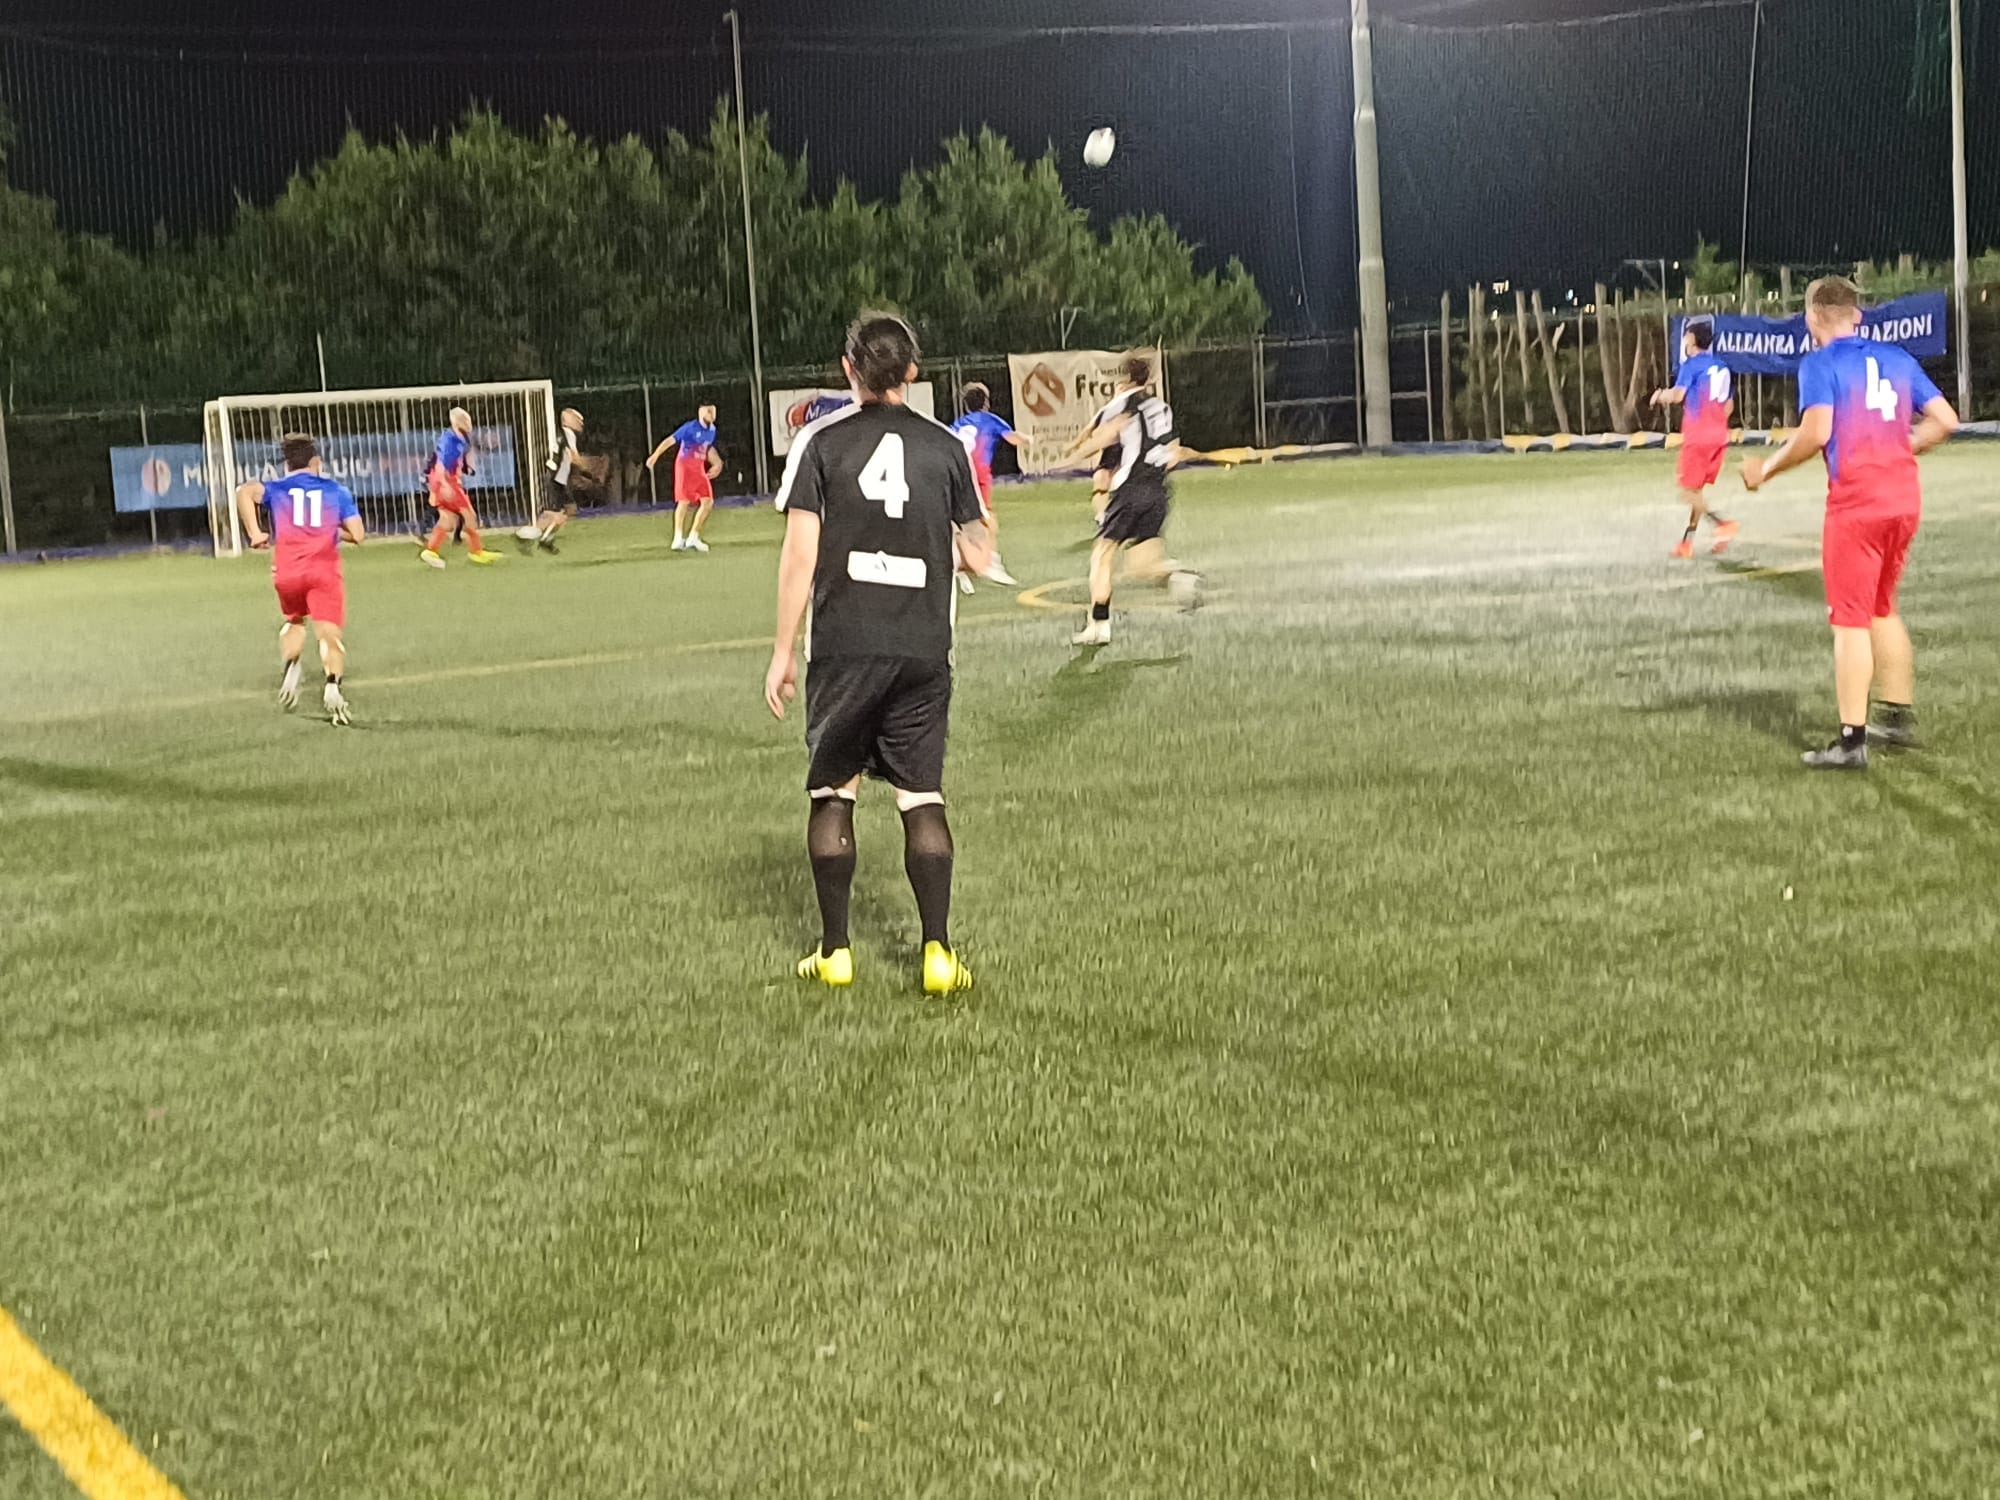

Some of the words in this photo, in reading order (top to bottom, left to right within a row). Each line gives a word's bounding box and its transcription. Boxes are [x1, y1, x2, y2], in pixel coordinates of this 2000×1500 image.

[1717, 331, 1795, 354] ALLEANZA
[1707, 365, 1731, 403] 10
[1864, 357, 1898, 422] 4
[858, 432, 910, 519] 4
[289, 487, 323, 528] 11
